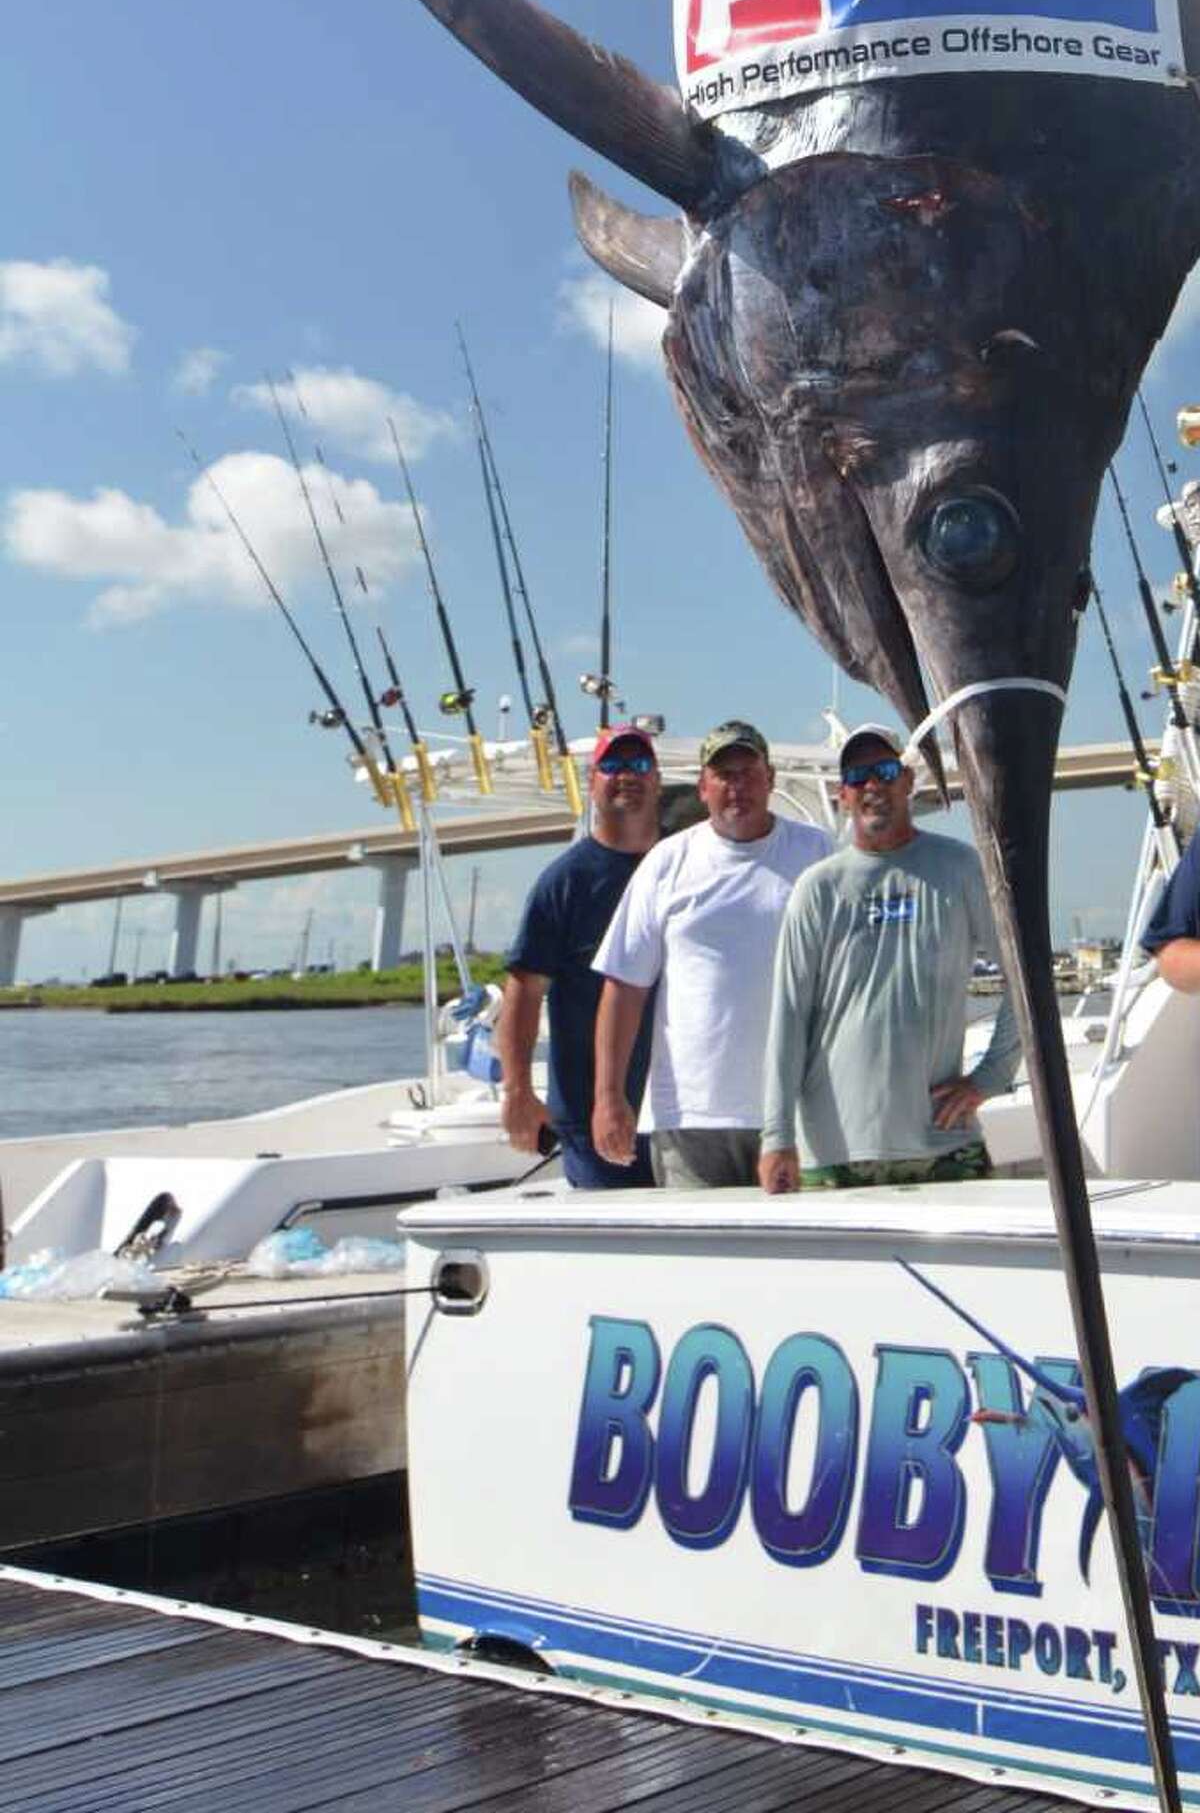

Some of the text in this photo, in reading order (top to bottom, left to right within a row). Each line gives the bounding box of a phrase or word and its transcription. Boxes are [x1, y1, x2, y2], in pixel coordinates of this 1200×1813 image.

[687, 27, 1161, 104] High Performance Offshore Gear
[568, 1314, 1085, 1599] BOOBY
[915, 1603, 1127, 1694] FREEPORT,
